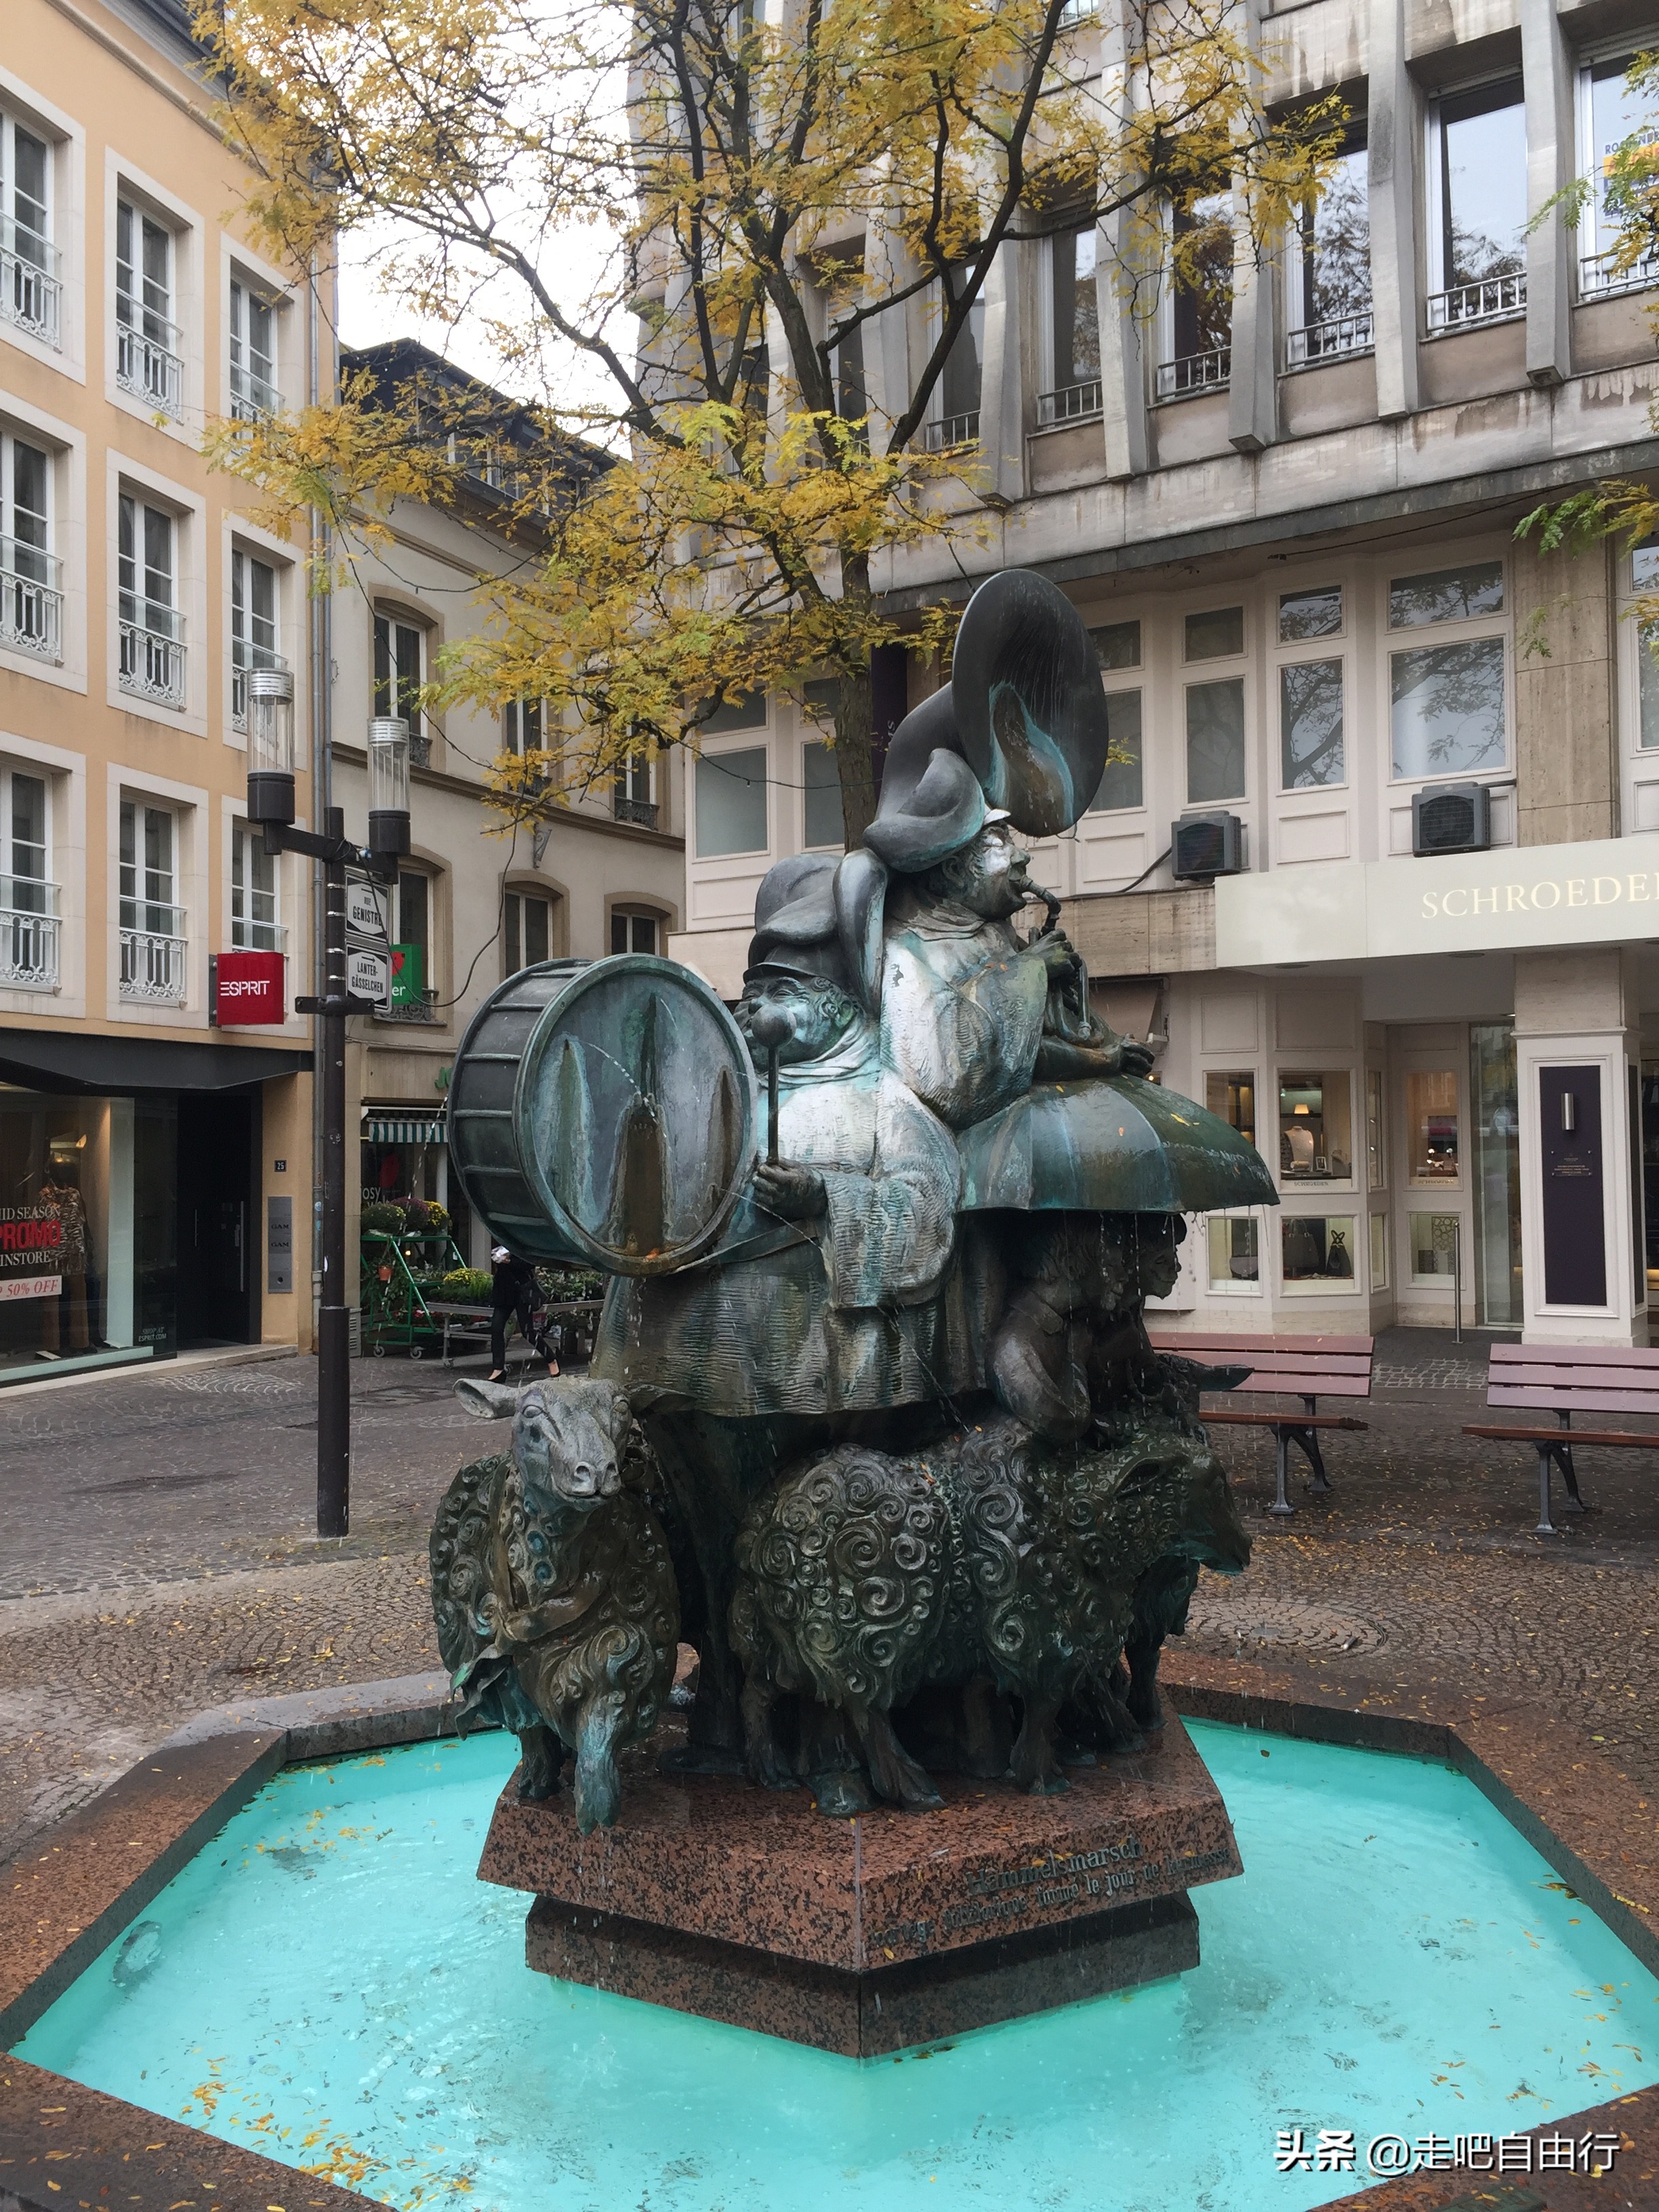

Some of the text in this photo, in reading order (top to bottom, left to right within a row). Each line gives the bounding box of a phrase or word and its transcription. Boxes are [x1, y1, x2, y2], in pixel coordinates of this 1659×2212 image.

[352, 905, 382, 926] GENISTRE
[357, 962, 379, 976] LANTER-
[220, 981, 270, 996] ESPRIT
[0, 1206, 61, 1221] ID SEASON
[0, 1250, 51, 1267] INSTORE
[6, 1282, 30, 1297] 50%
[35, 1279, 58, 1294] OFF
[965, 1834, 1143, 1896] Hammelsmarsch
[1084, 1874, 1100, 1896] le
[1105, 1868, 1136, 1896] jour
